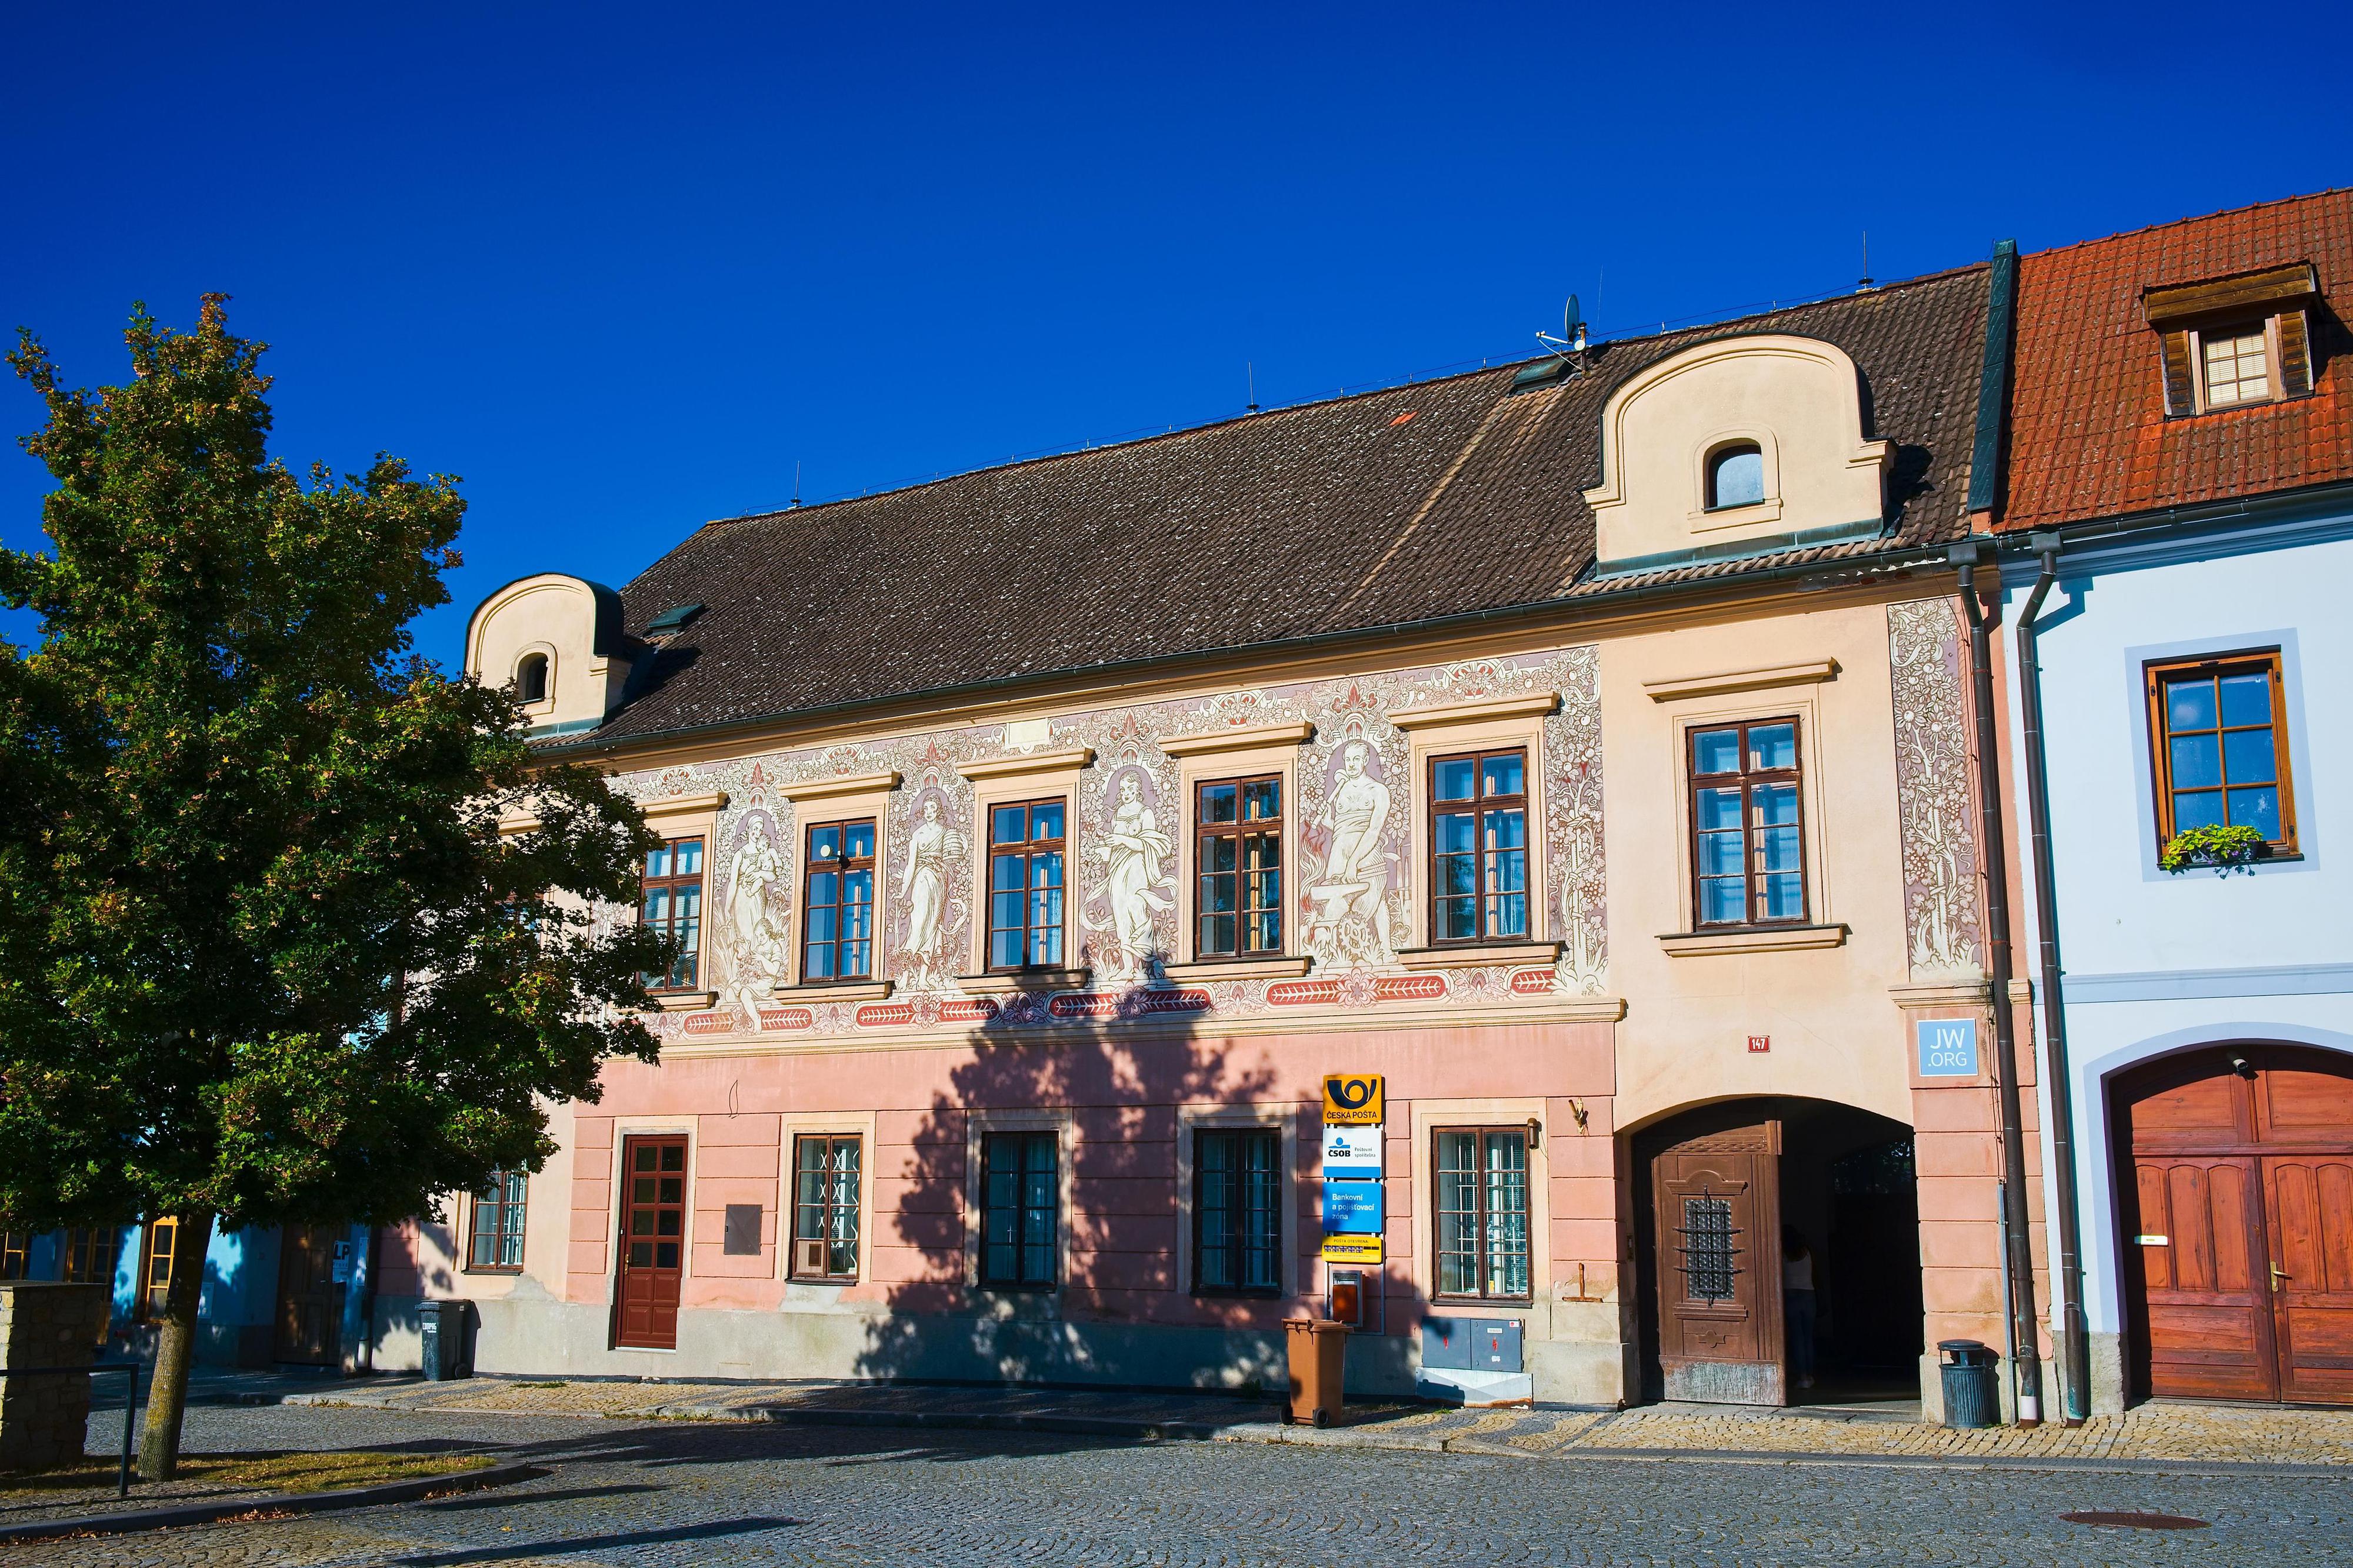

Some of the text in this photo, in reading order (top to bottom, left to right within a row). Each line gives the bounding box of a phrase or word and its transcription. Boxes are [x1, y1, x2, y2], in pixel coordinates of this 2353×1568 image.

[1752, 1038, 1765, 1049] 147
[1929, 1027, 1965, 1049] JW
[1928, 1052, 1967, 1067] .ORG
[1327, 1110, 1351, 1119] ČESKÁ
[1328, 1149, 1351, 1157] ČSOB
